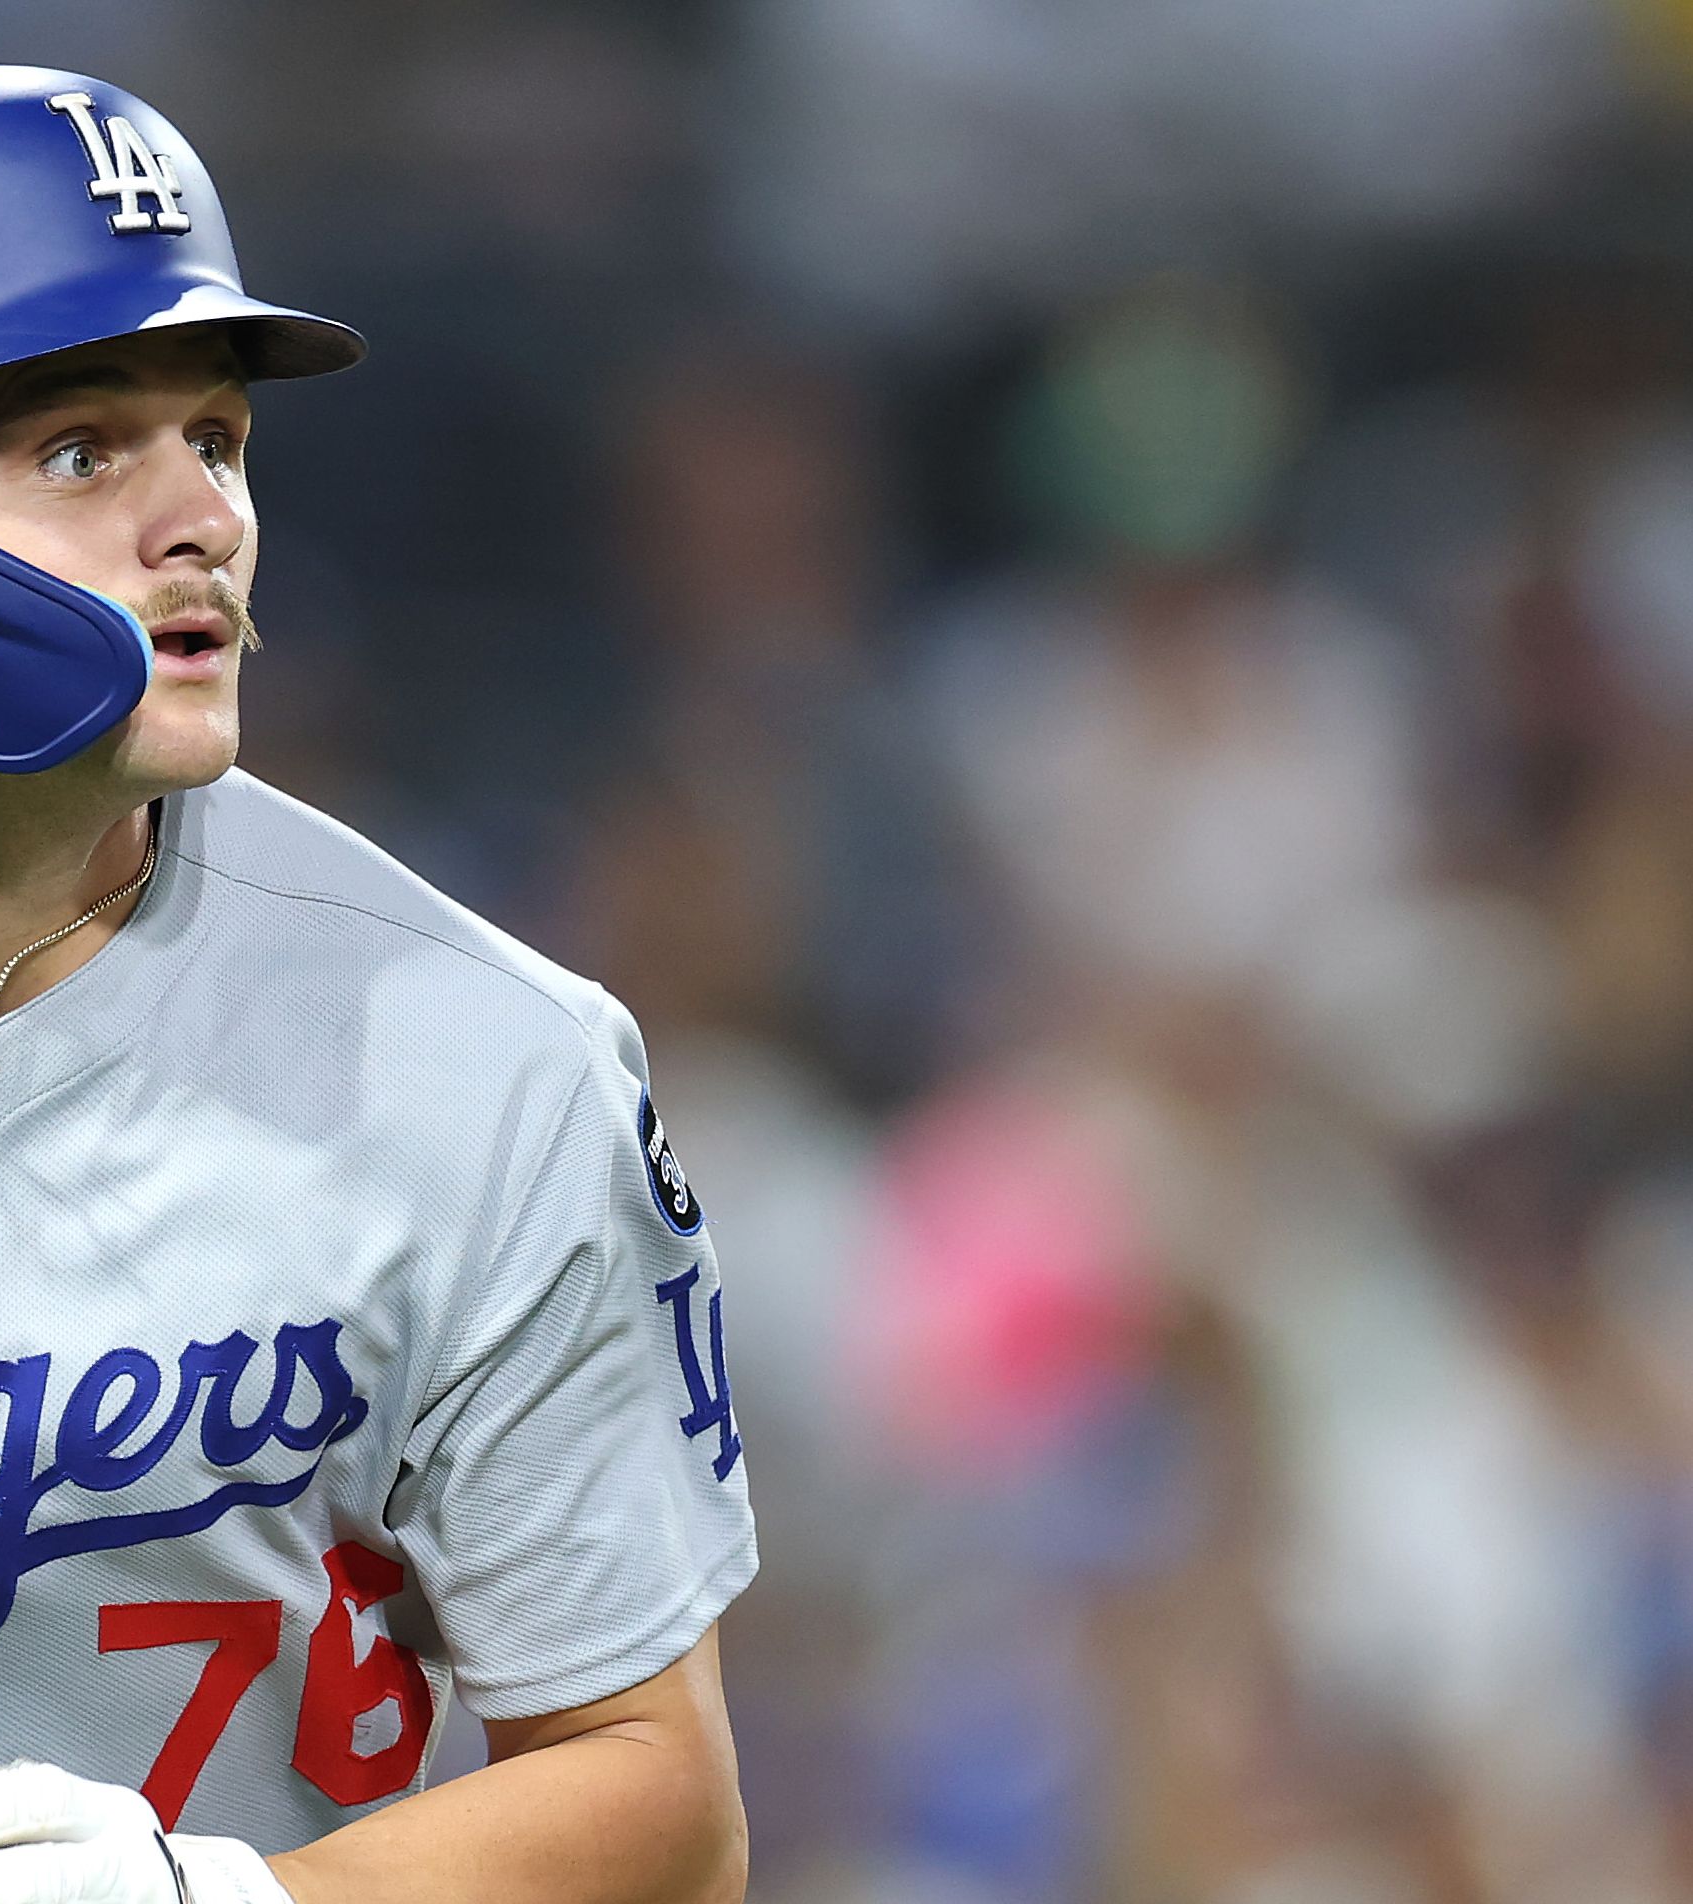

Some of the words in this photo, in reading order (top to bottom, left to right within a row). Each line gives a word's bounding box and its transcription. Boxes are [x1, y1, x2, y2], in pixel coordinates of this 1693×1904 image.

[47, 92, 191, 233] LA
[660, 1150, 689, 1215] 3
[97, 1538, 432, 1835] 76
